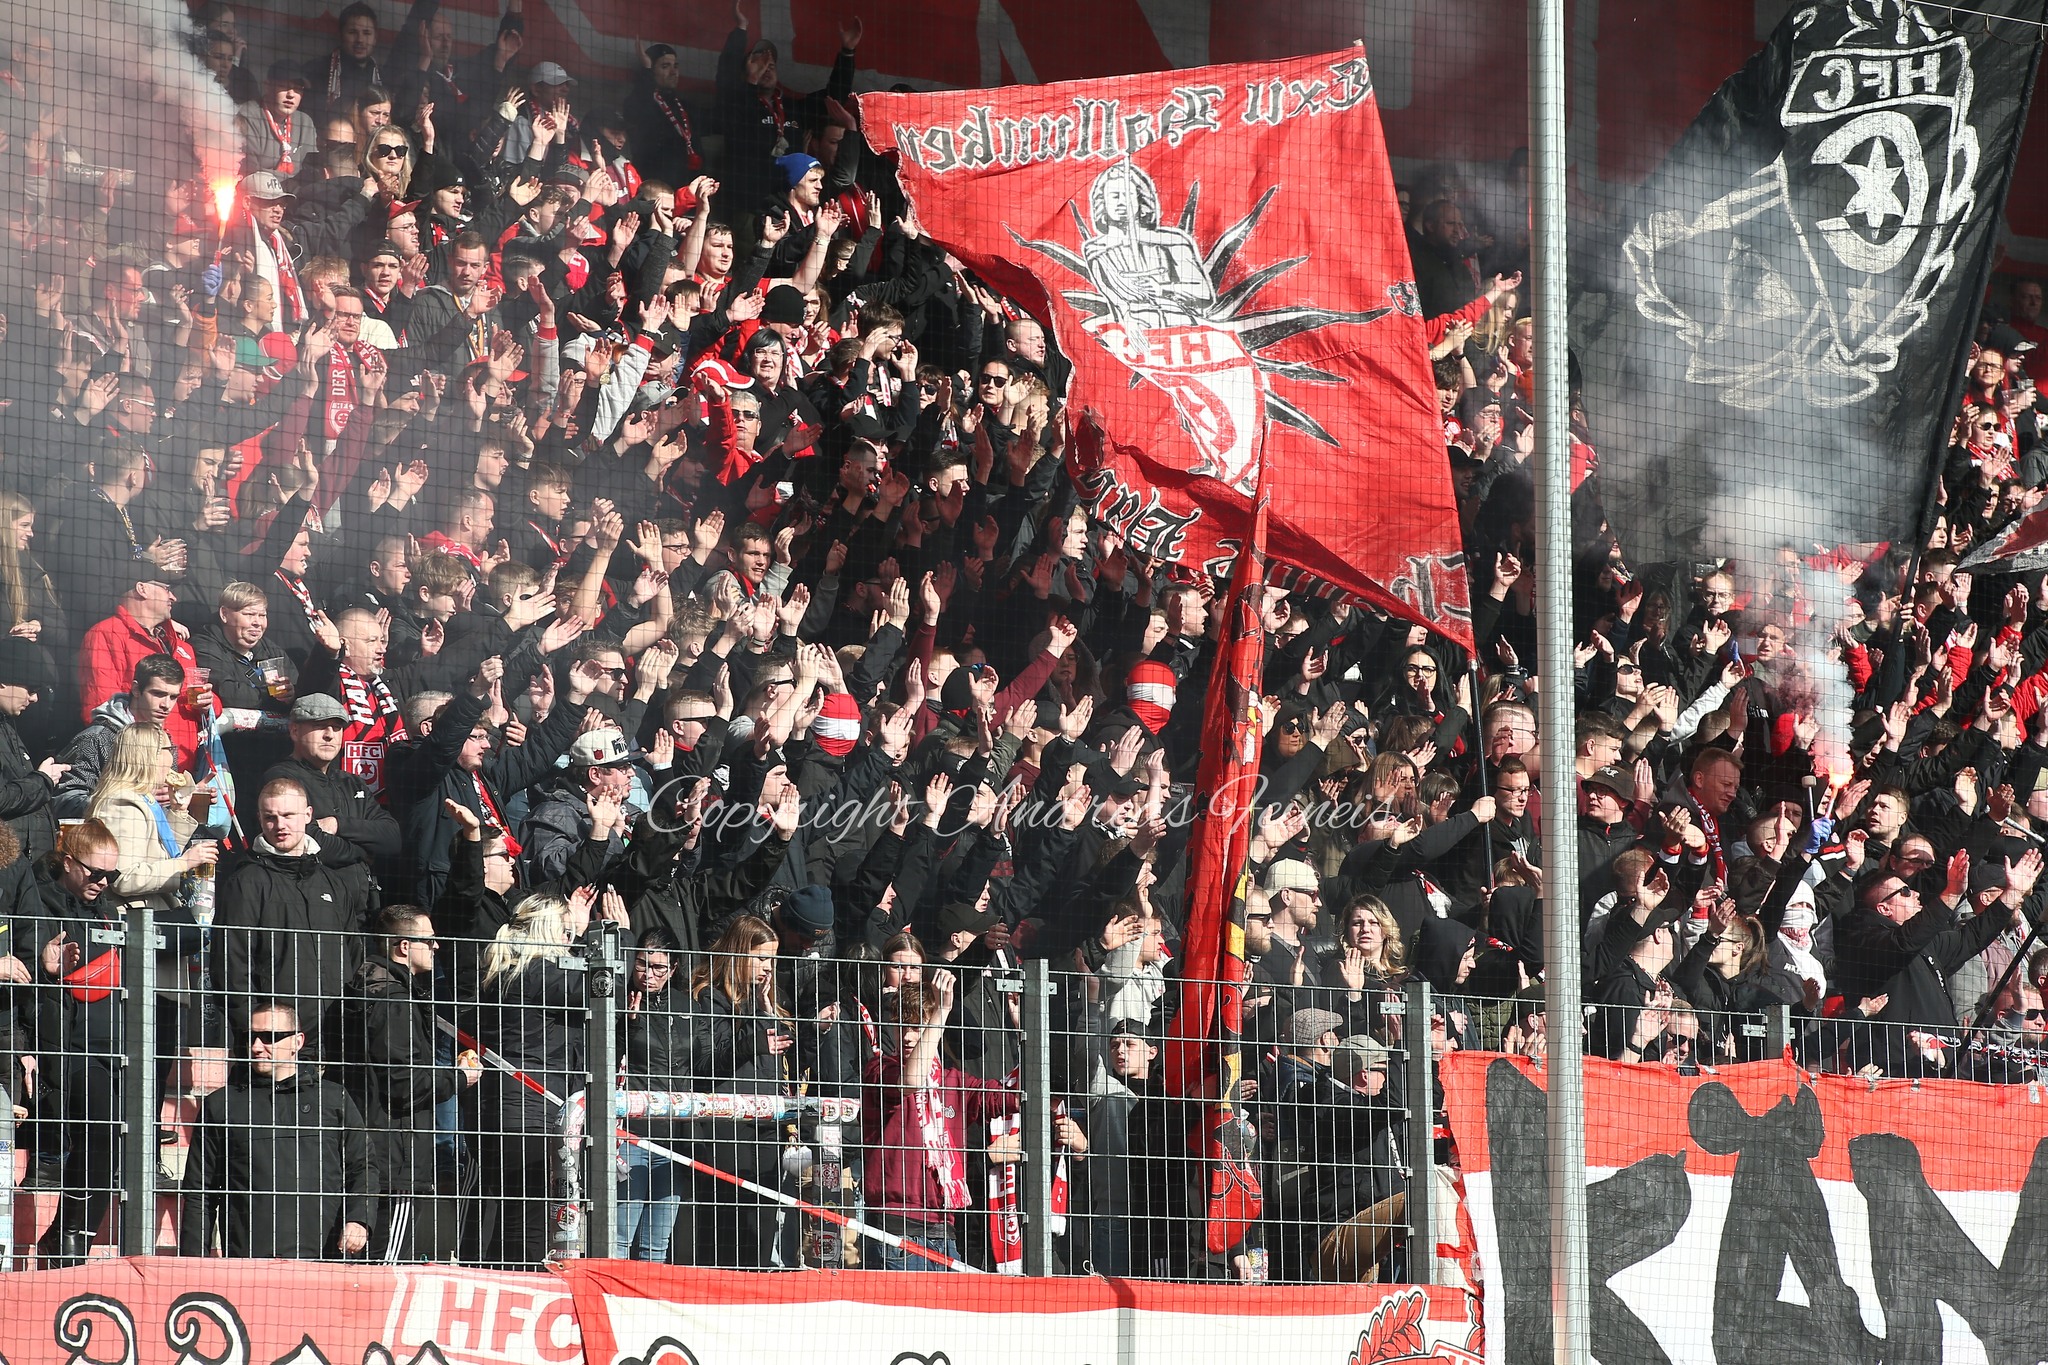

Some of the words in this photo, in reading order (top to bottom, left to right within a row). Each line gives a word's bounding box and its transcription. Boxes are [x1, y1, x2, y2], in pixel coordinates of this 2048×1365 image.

[332, 369, 346, 396] DER
[349, 746, 380, 758] HFC
[435, 1279, 587, 1363] HFC
